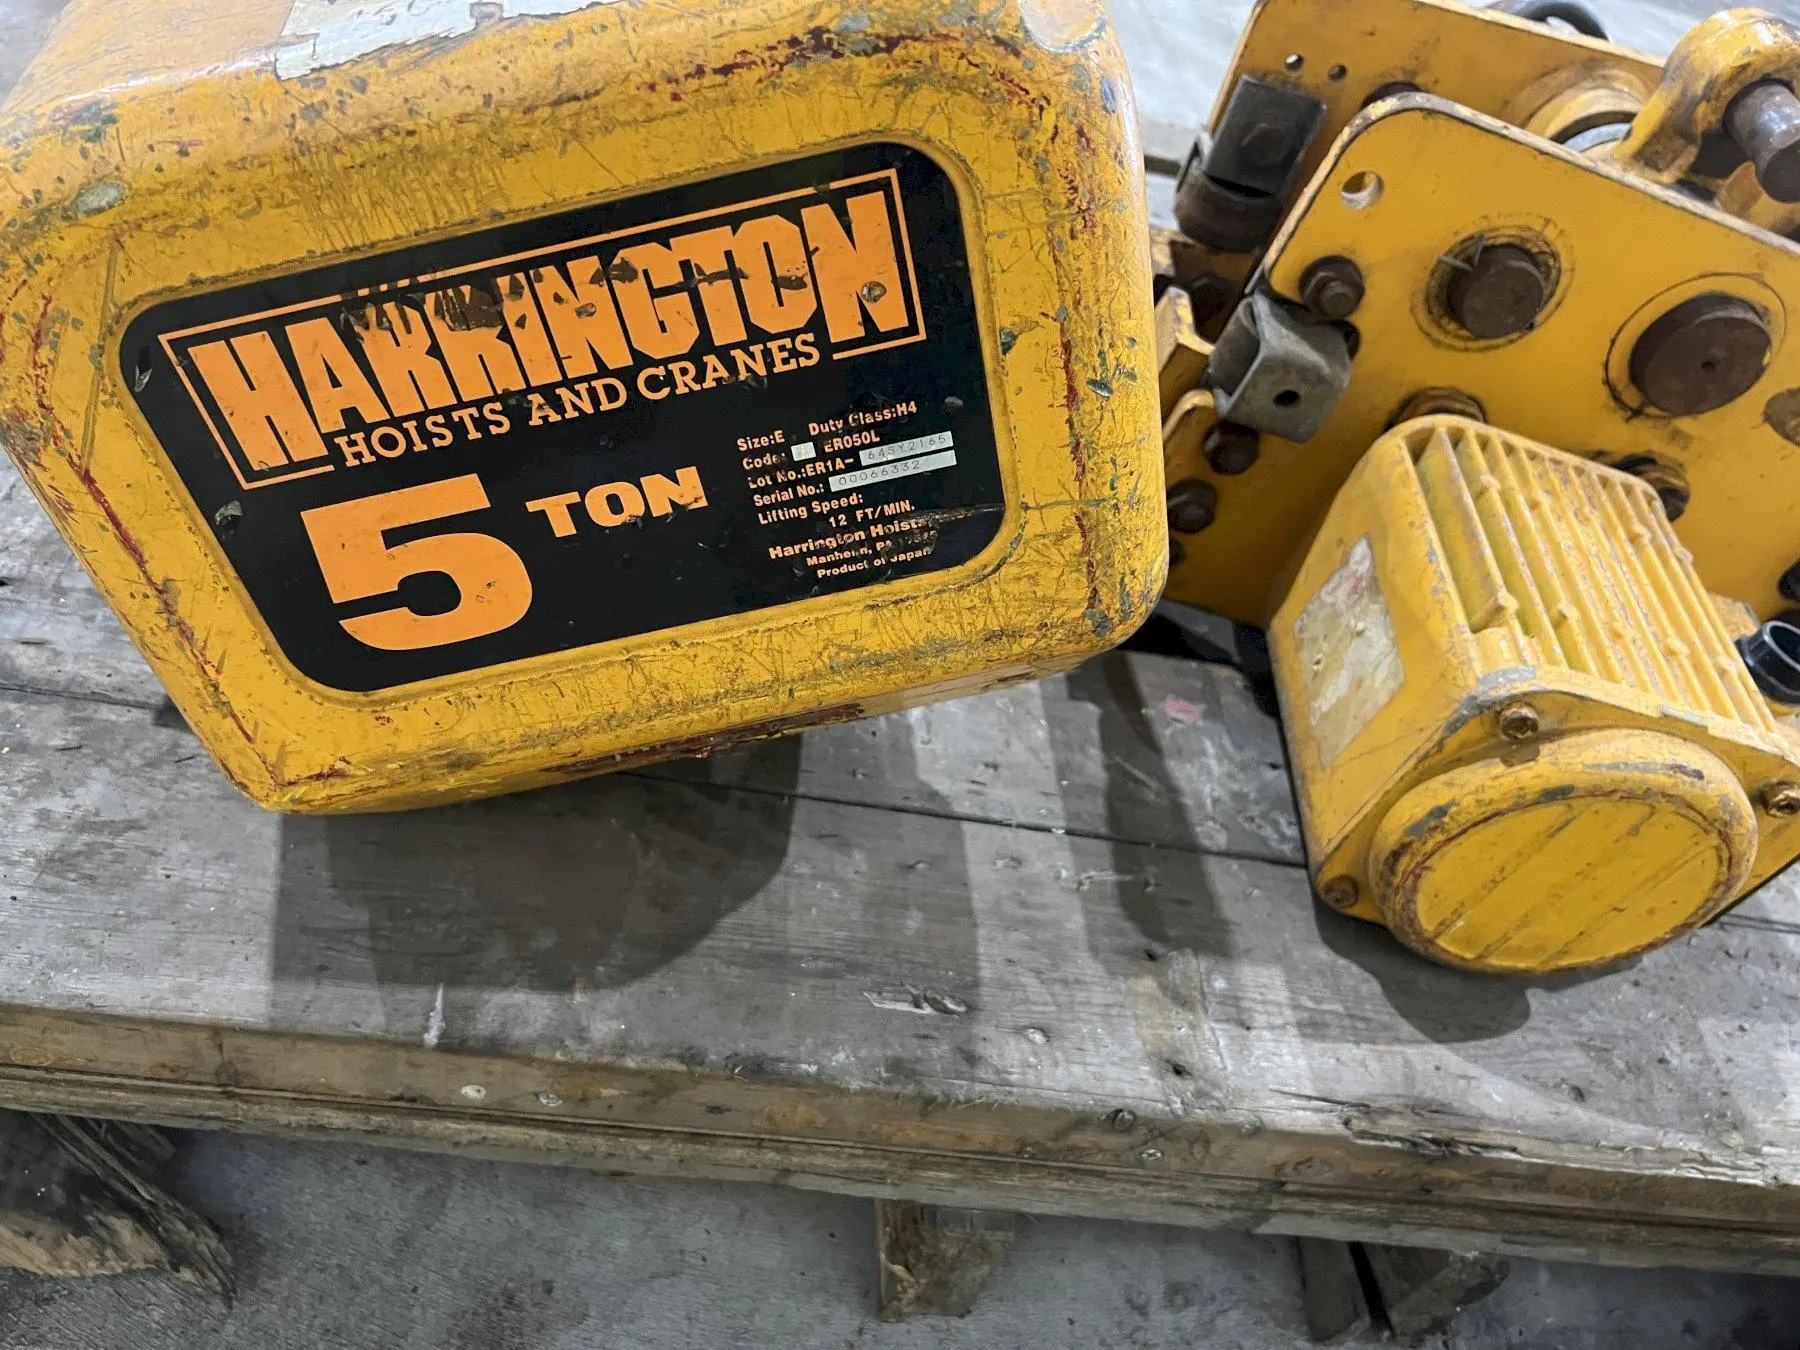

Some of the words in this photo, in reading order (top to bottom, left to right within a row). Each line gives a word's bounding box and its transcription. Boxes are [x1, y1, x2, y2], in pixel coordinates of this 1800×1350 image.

[188, 191, 908, 470] HARRINGTON
[334, 401, 510, 467] HOISTS
[528, 378, 627, 427] AND
[637, 333, 820, 400] CRANES
[737, 429, 785, 451] Size:E
[808, 419, 844, 436] Duty
[848, 401, 918, 427] Class:H4
[742, 452, 788, 470] Code:
[823, 429, 881, 453] ER050L
[753, 488, 793, 507] Serial
[796, 483, 824, 498] No.:
[838, 460, 920, 486] 00066332
[758, 505, 808, 525] Lifting
[812, 493, 864, 514] Speed:
[829, 514, 848, 528] 12
[855, 500, 915, 522] FT/MIN.
[301, 473, 532, 650] 5
[525, 466, 708, 538] TON
[769, 531, 865, 560] Harrington
[817, 560, 869, 578] Product
